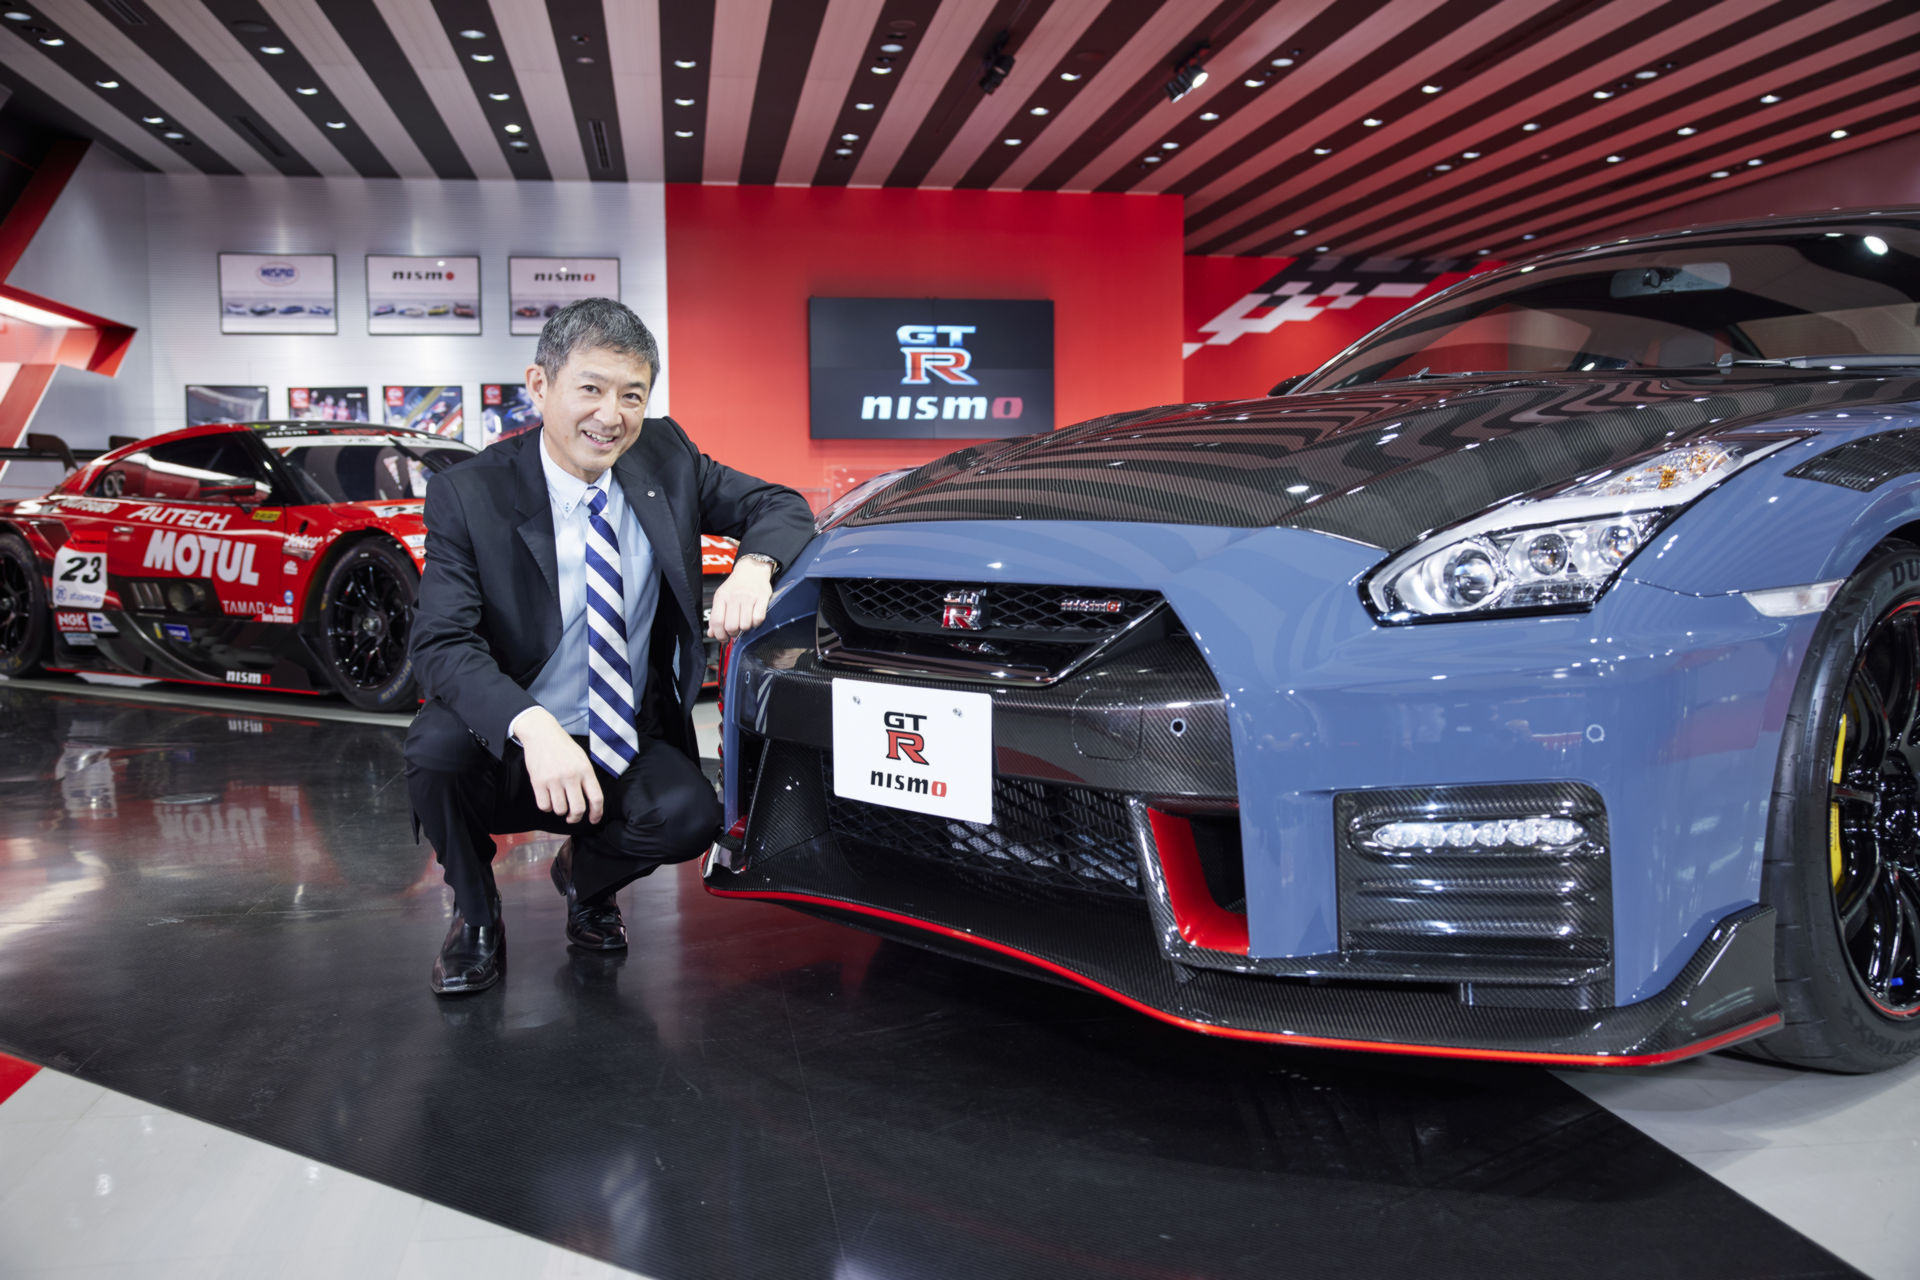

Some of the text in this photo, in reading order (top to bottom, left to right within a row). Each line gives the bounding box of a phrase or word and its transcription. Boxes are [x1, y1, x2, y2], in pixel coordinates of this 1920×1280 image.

[534, 272, 596, 282] nismo
[896, 324, 977, 347] GT
[899, 347, 979, 386] R
[861, 396, 1023, 420] nismo
[126, 505, 232, 531] AUTECH
[59, 556, 102, 584] 23
[142, 529, 260, 586] MOTUL
[58, 613, 88, 627] NGK
[226, 670, 272, 685] nismo
[883, 711, 928, 731] GT
[885, 728, 930, 766] R
[870, 770, 948, 798] nismo
